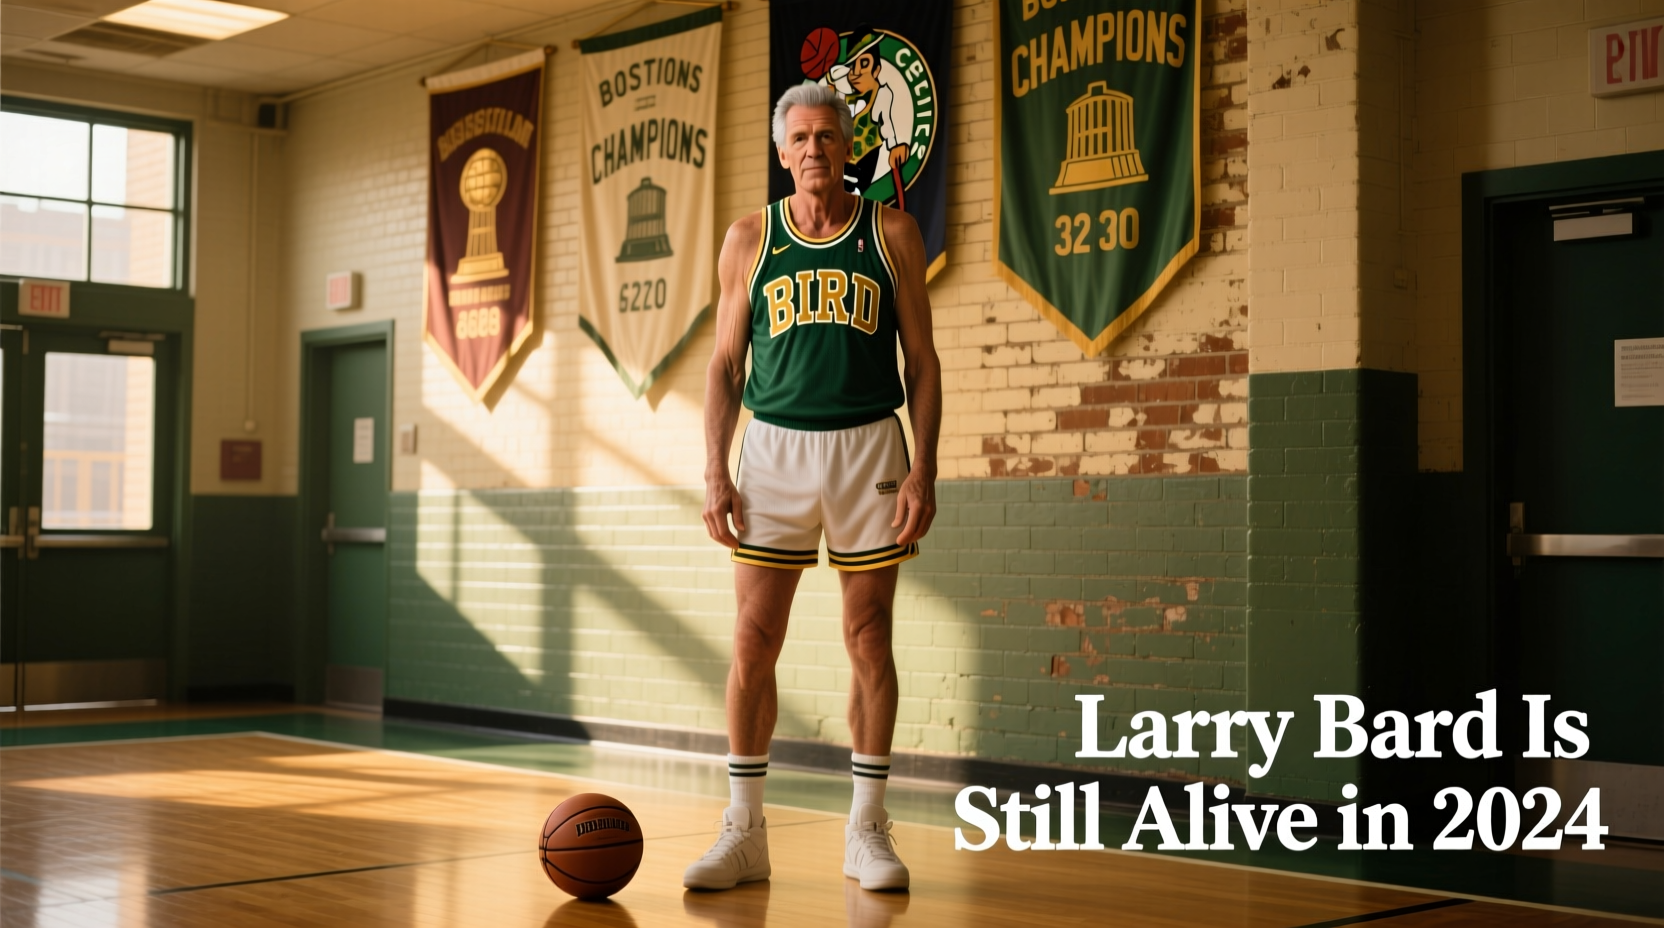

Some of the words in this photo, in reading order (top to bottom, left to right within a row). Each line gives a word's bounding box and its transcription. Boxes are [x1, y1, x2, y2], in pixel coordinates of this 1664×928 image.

[599, 57, 703, 108] BOSTIONS
[1012, 9, 1187, 97] CHAMPIONS
[592, 117, 708, 185] CHAMPIONS
[1055, 212, 1091, 256] 32
[1099, 207, 1139, 250] 30
[763, 268, 880, 339] BIRD
